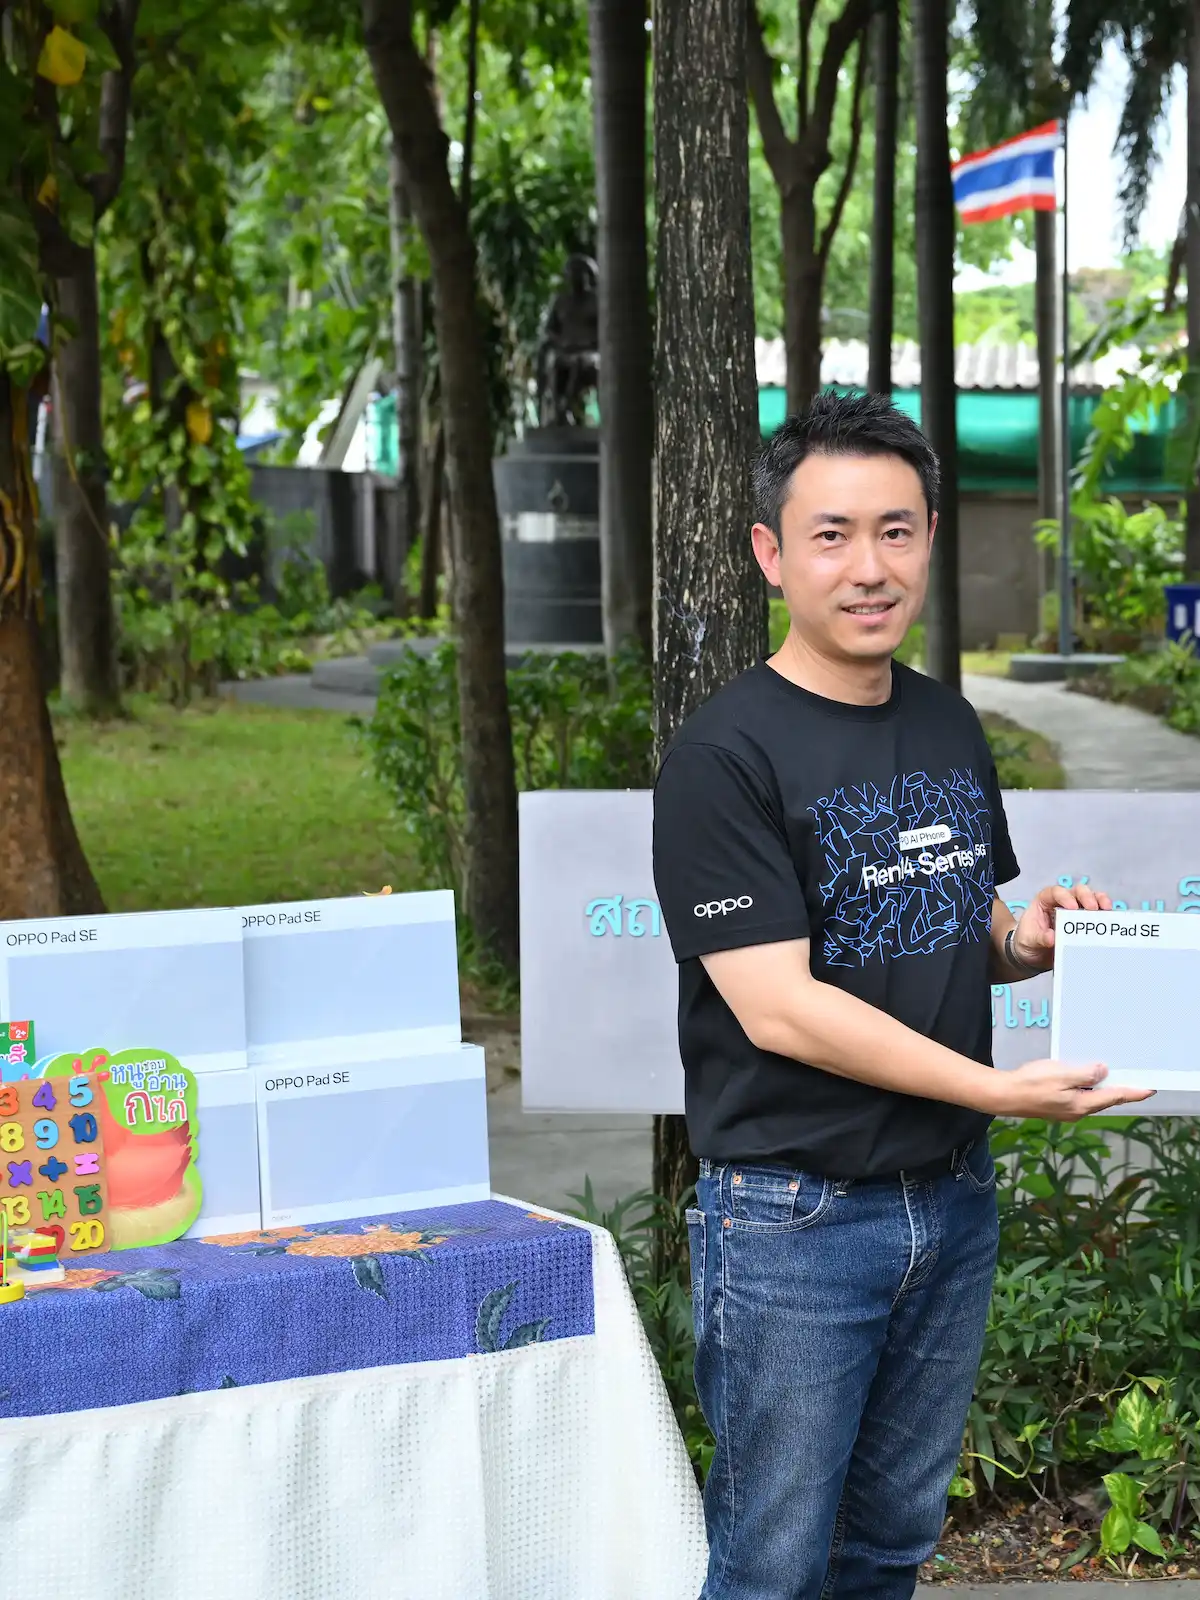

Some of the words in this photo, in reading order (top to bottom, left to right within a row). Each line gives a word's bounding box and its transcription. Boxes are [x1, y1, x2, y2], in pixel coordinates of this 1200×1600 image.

[911, 834, 919, 844] AI
[919, 831, 946, 842] Phone
[918, 845, 974, 875] Series
[975, 844, 986, 858] 5G
[279, 912, 302, 924] Pad
[304, 911, 321, 922] SE
[694, 895, 753, 918] oppo
[6, 932, 48, 946] OPPO
[51, 930, 76, 943] Pad
[79, 929, 98, 941] SE
[1063, 921, 1107, 935] OPPO
[1111, 923, 1137, 937] Pad
[1140, 924, 1160, 937] SE
[265, 1076, 304, 1091] OPPO
[307, 1074, 330, 1086] Pad
[333, 1071, 350, 1084] SE
[32, 1081, 57, 1111] 4
[68, 1077, 93, 1107] 5
[0, 1121, 25, 1152] 8
[33, 1118, 59, 1149] 9
[68, 1112, 98, 1144] 10
[1, 1195, 31, 1226] 13
[36, 1189, 67, 1220] 14
[73, 1184, 103, 1216] 15
[69, 1219, 104, 1251] 20
